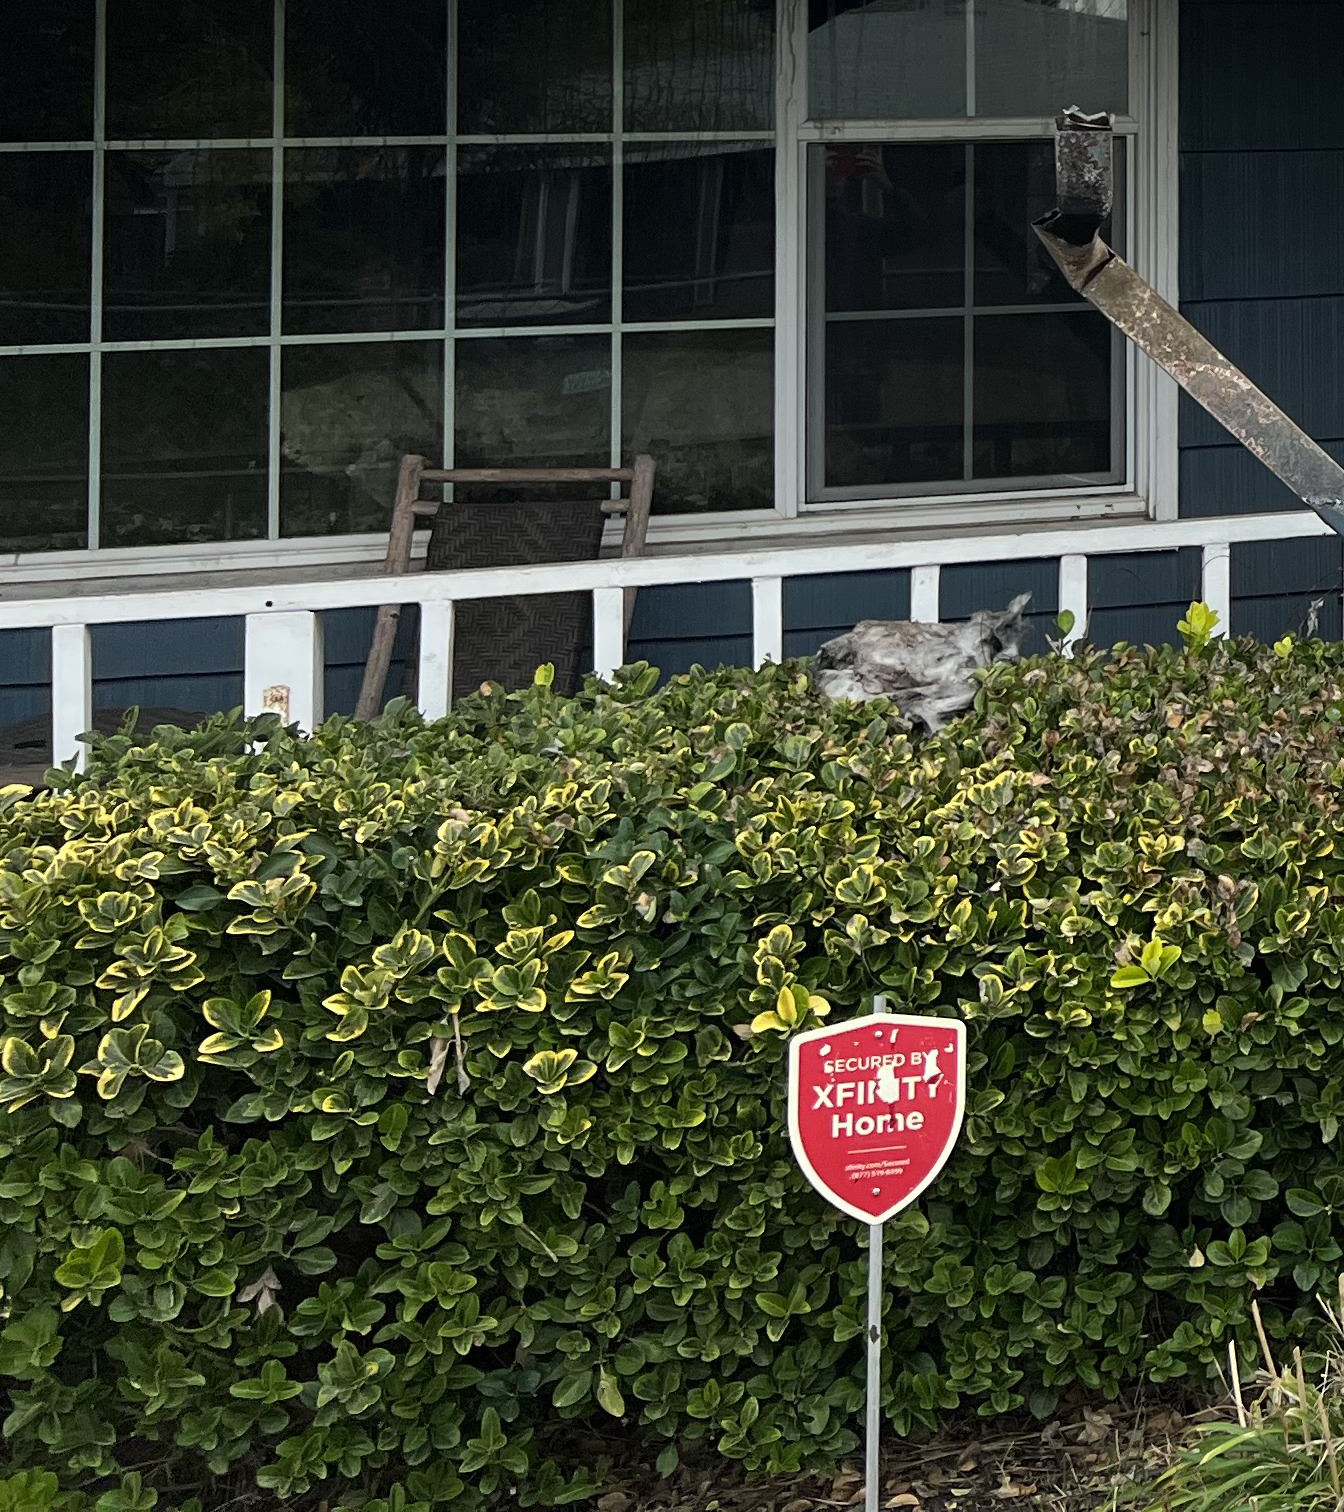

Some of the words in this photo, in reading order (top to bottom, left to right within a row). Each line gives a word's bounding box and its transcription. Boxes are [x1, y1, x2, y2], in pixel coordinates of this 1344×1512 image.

[823, 1052, 906, 1074] SECURED
[811, 1073, 944, 1110] XFITY
[831, 1110, 925, 1139] Home
